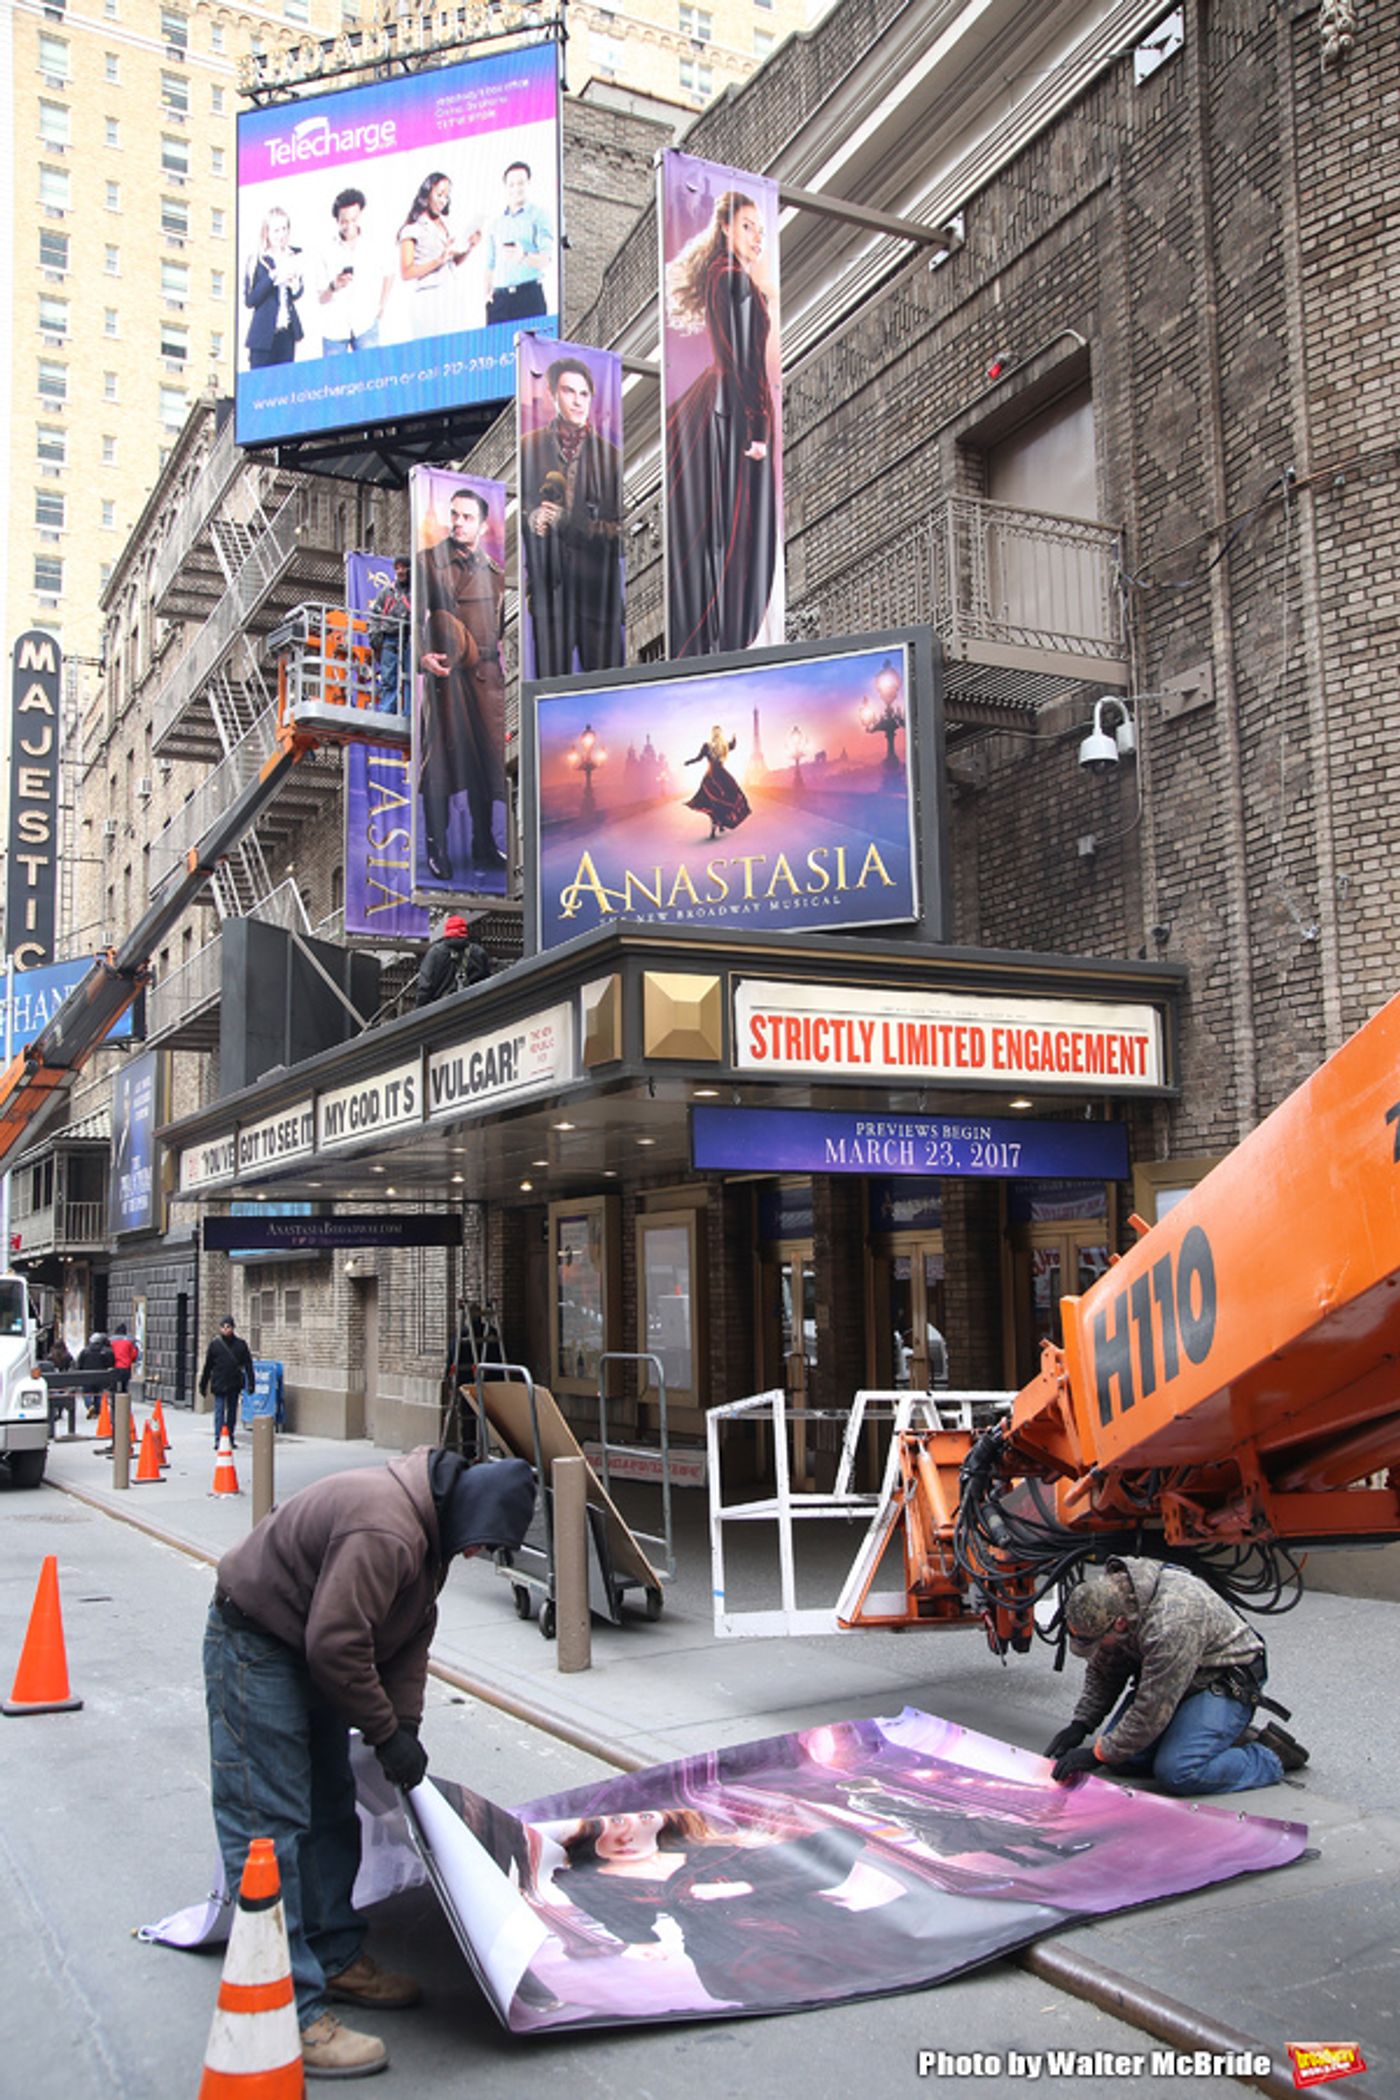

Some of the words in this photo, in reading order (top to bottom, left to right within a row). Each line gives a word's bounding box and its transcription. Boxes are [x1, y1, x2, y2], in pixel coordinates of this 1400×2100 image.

[264, 116, 397, 168] Telecharge
[14, 640, 56, 973] MAJESTIC
[558, 842, 897, 920] ANASTASIA
[676, 902, 762, 920] BROADWAY
[769, 895, 842, 911] MUSICAL
[749, 1014, 876, 1064] STRICTLY
[882, 1021, 986, 1068] LIMITED
[992, 1028, 1150, 1076] ENGAGEMENT
[240, 1132, 260, 1165] GOT
[262, 1126, 276, 1157] TO
[278, 1117, 299, 1152] SEE
[325, 1098, 347, 1138] MY
[825, 1138, 915, 1166] MARCH
[925, 1141, 961, 1169] 23,
[970, 1143, 1022, 1169] 2017
[856, 1122, 938, 1138] PREVIEWS
[942, 1125, 992, 1141] BEGIN
[1094, 1224, 1217, 1428] H110
